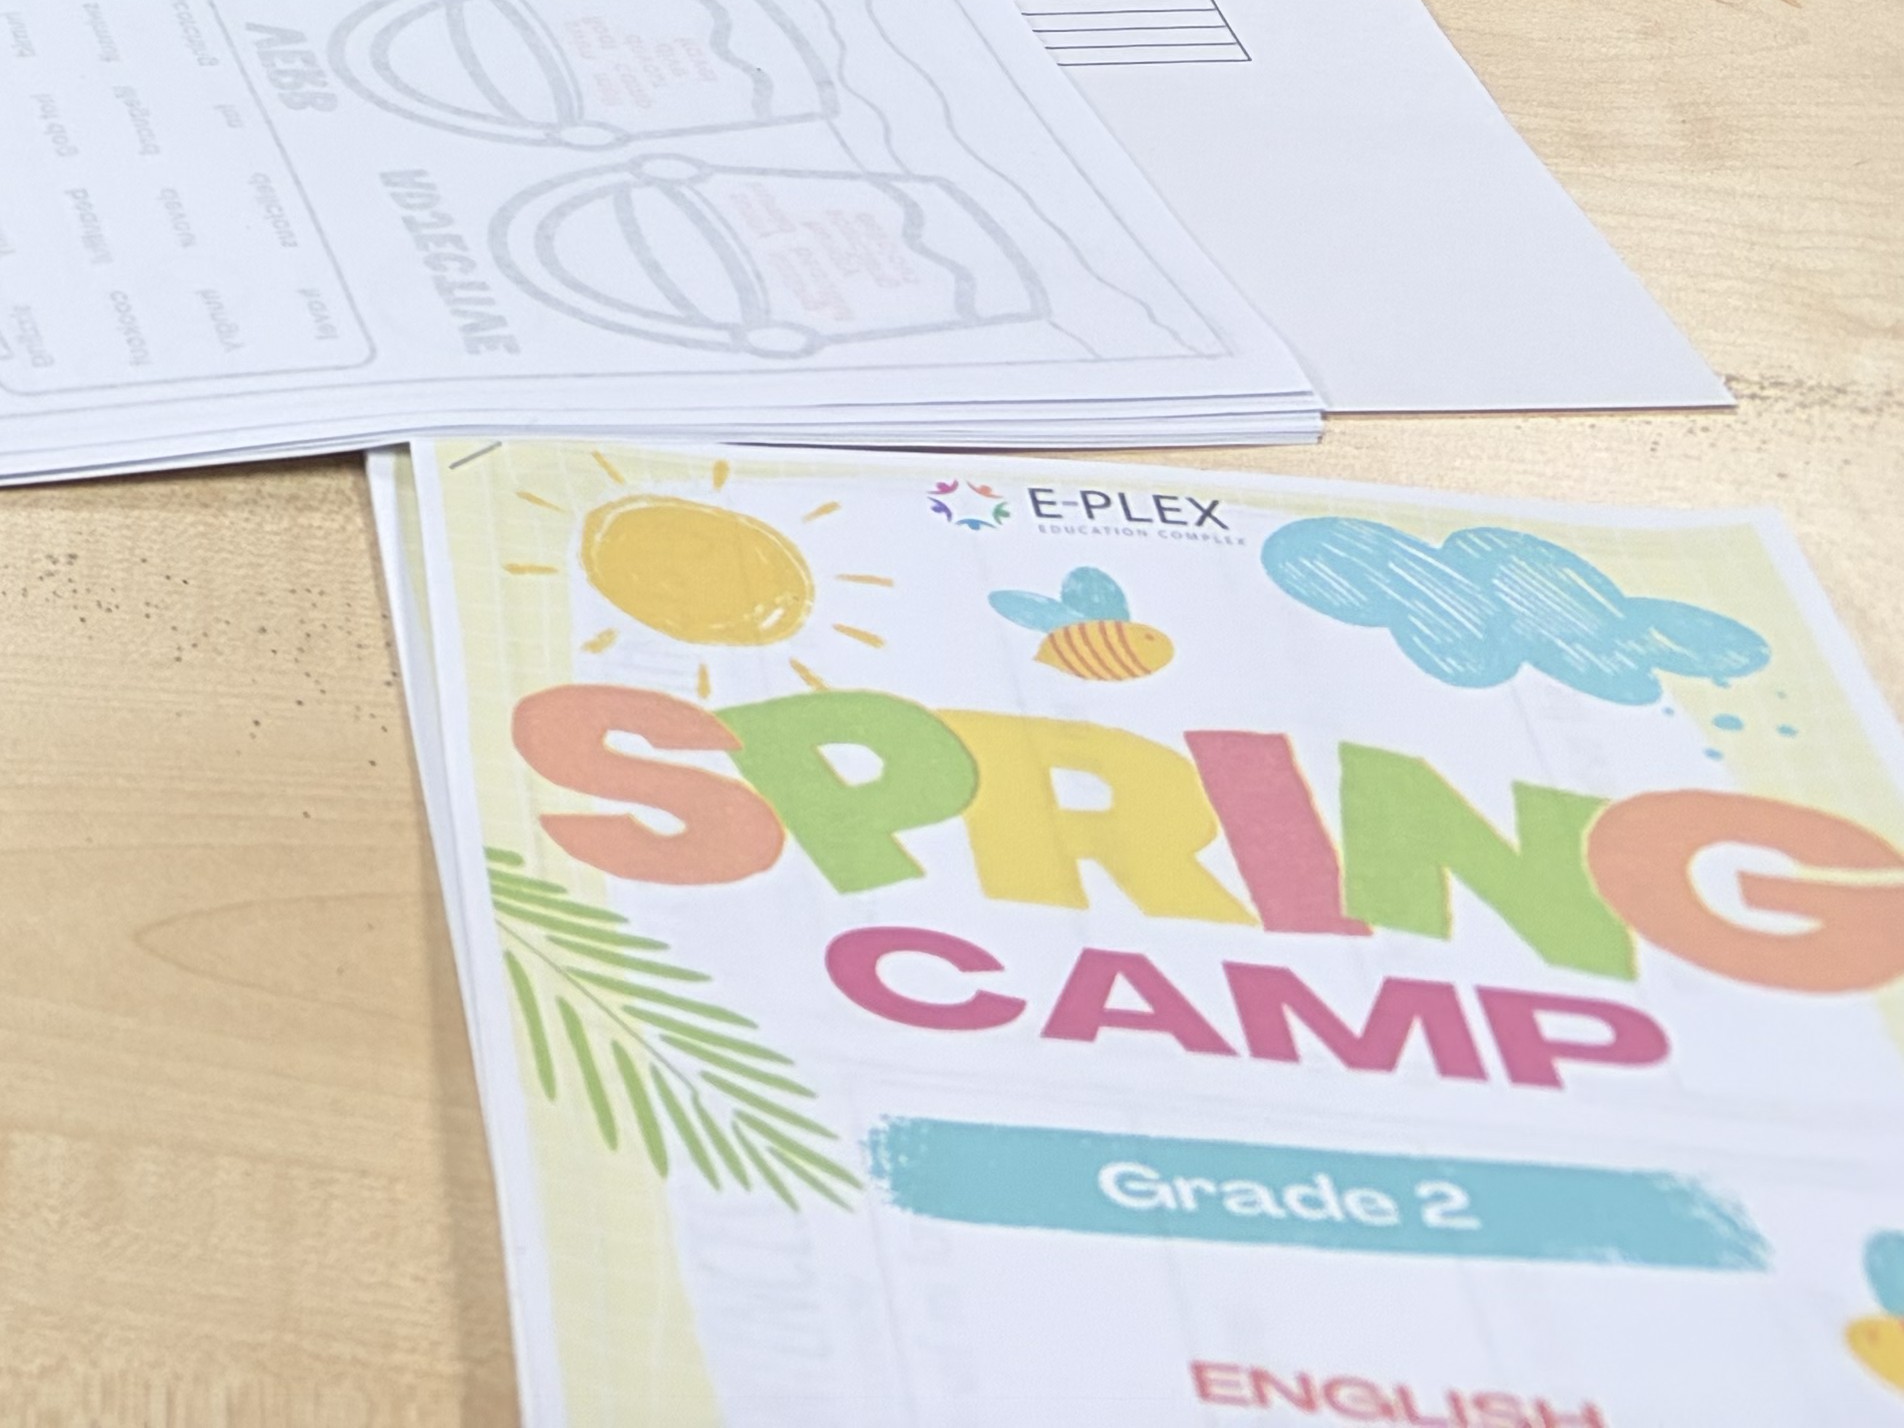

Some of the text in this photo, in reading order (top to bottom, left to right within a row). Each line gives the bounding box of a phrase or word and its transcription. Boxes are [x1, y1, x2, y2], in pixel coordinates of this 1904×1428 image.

[1027, 487, 1231, 532] E-PLEX
[1038, 523, 1149, 538] EDUCATION
[510, 684, 1904, 994] SPRING
[824, 926, 1673, 1094] CAMP
[1098, 1158, 1484, 1233] Grade 2
[1190, 1359, 1606, 1428] ENGLISH
